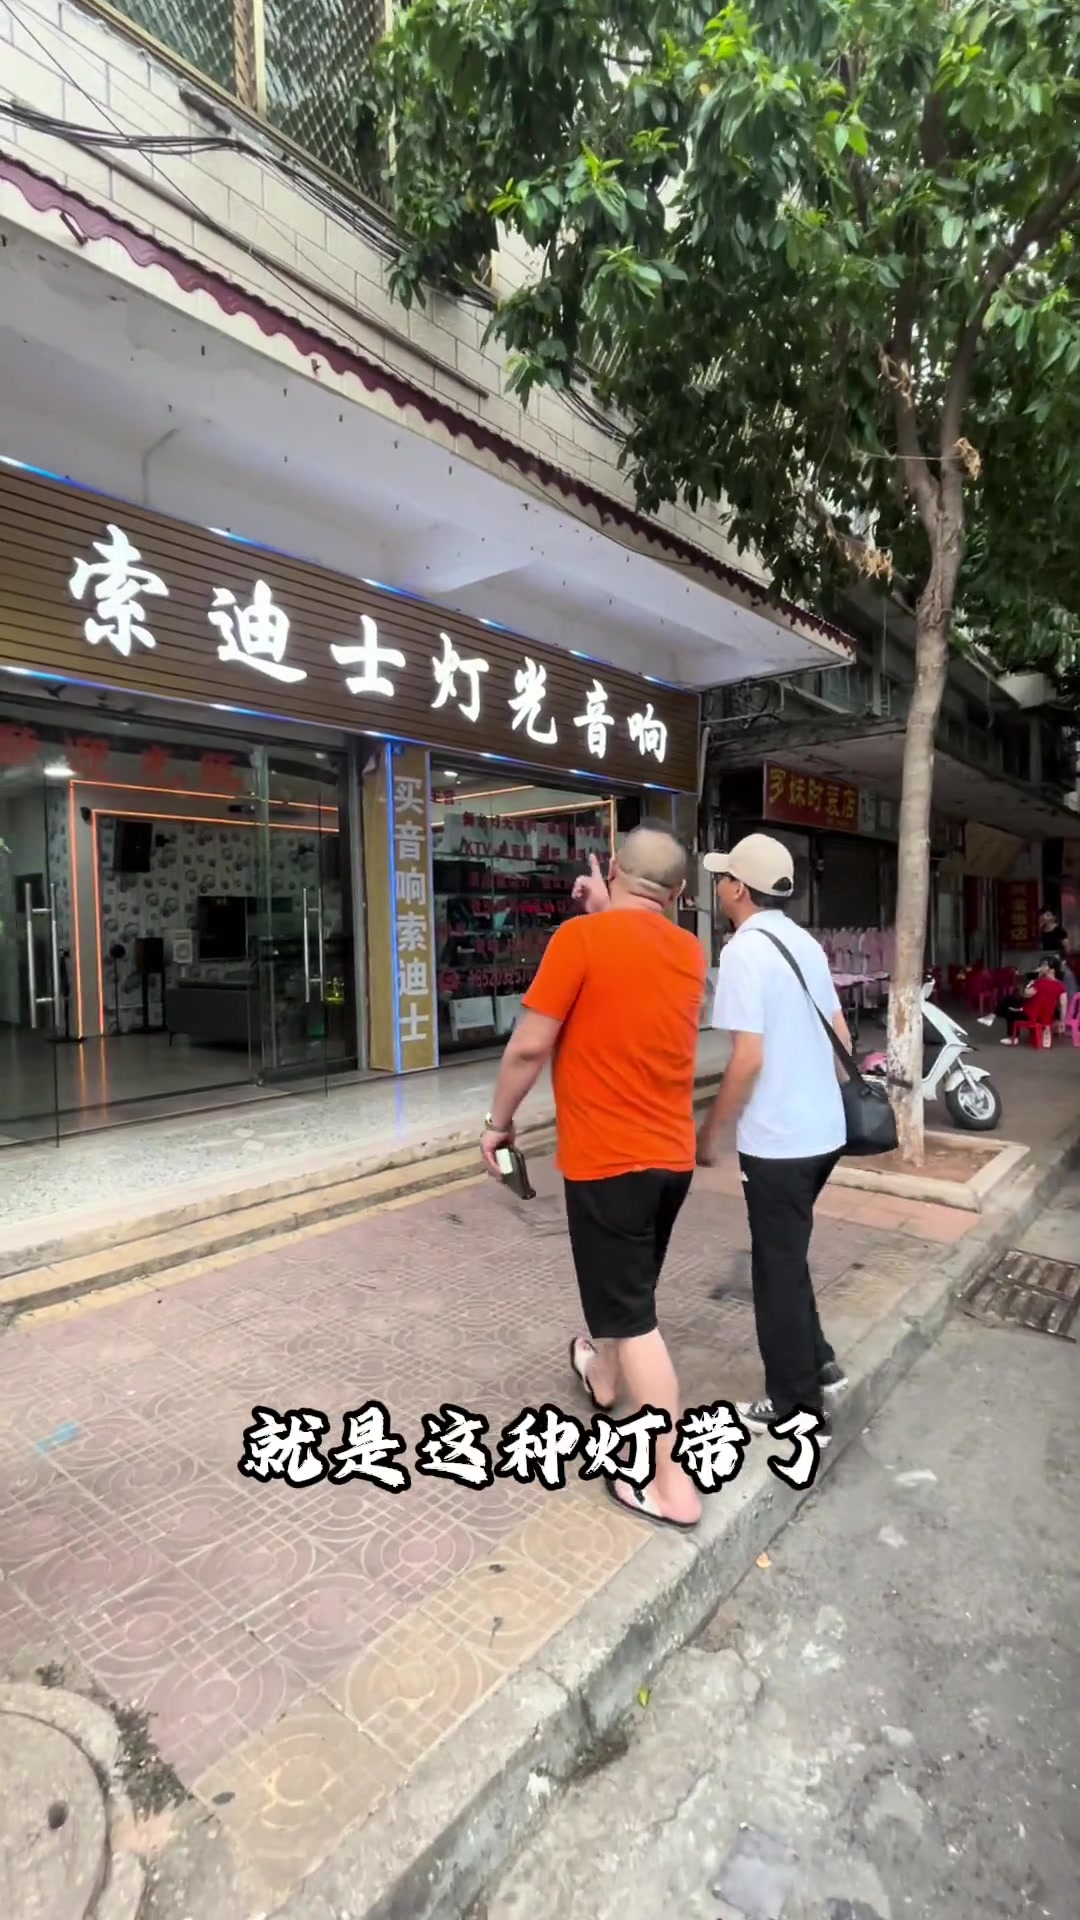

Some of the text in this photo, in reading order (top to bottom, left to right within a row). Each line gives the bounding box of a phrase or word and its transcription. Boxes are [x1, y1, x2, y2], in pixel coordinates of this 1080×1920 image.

[69, 524, 668, 764] 索迪士灯光音响
[395, 776, 430, 1043] 买音响索迪士
